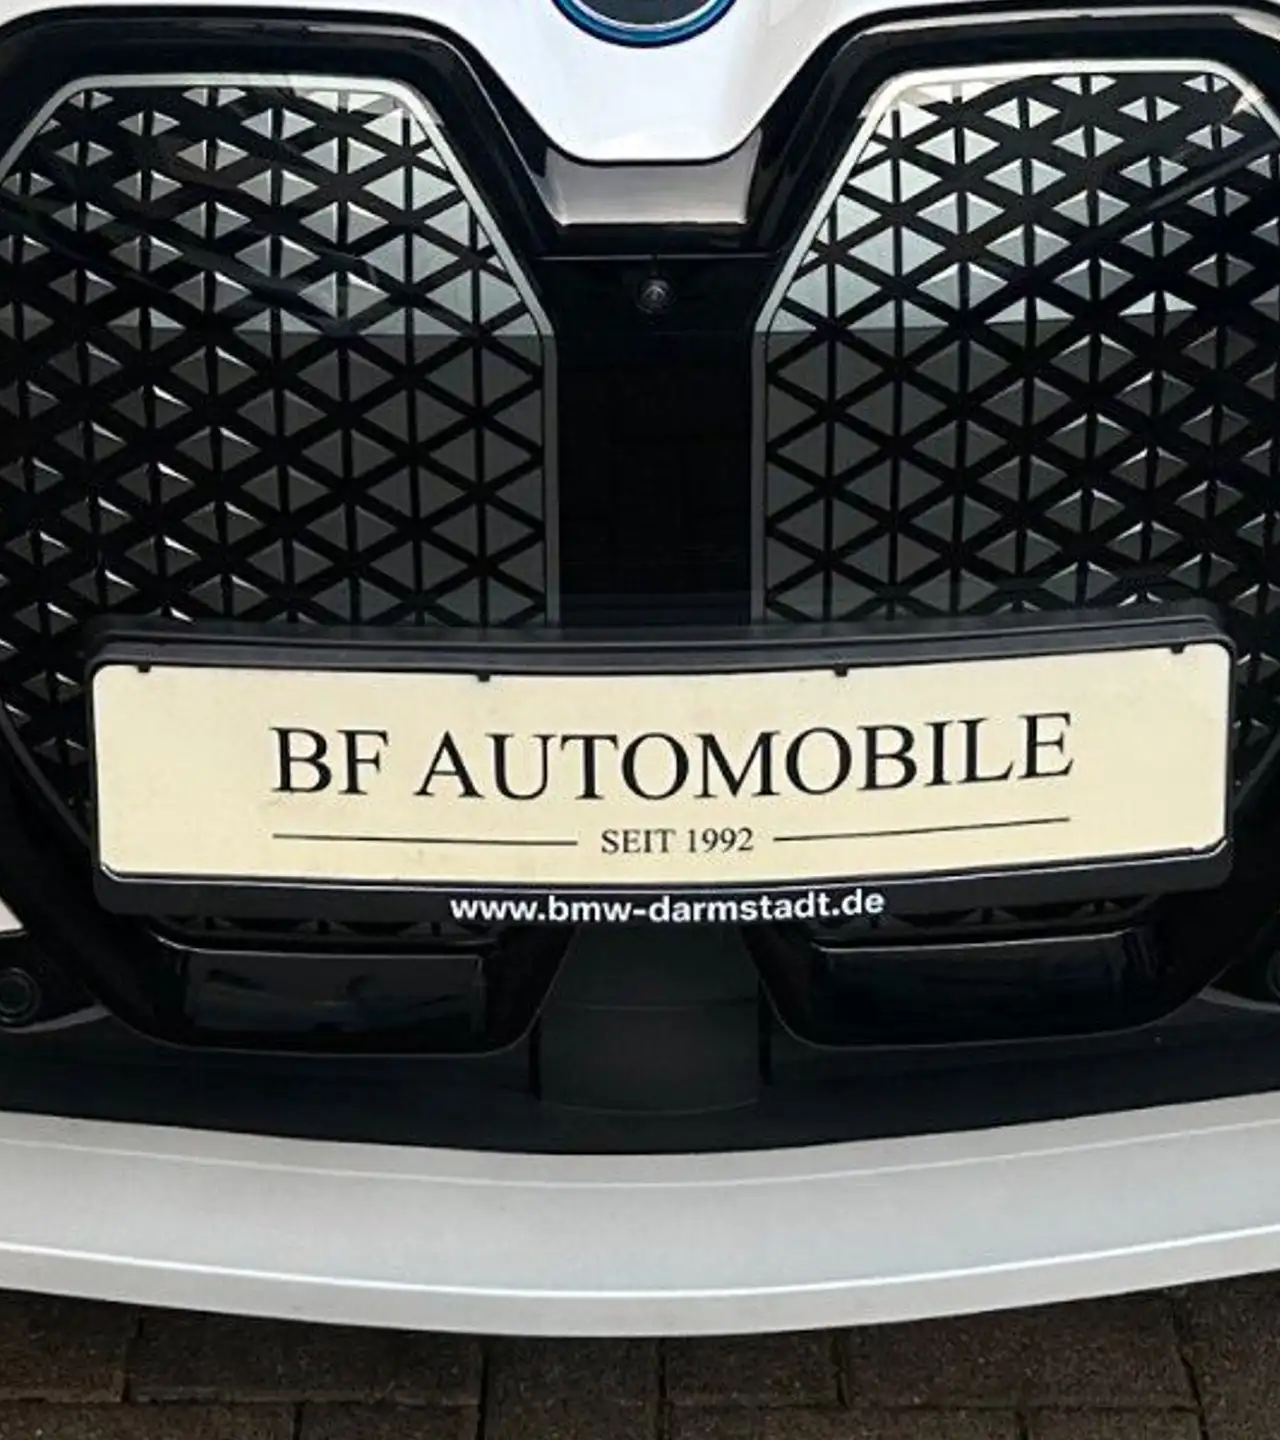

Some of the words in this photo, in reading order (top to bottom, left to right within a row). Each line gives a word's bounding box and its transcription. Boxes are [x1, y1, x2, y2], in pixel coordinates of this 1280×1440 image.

[271, 727, 389, 796] BF
[413, 712, 1073, 801] AUTOMOBILE
[601, 829, 676, 855] SEIT
[686, 827, 754, 853] 1992
[450, 888, 885, 923] www.bmw-darmstadt.de
